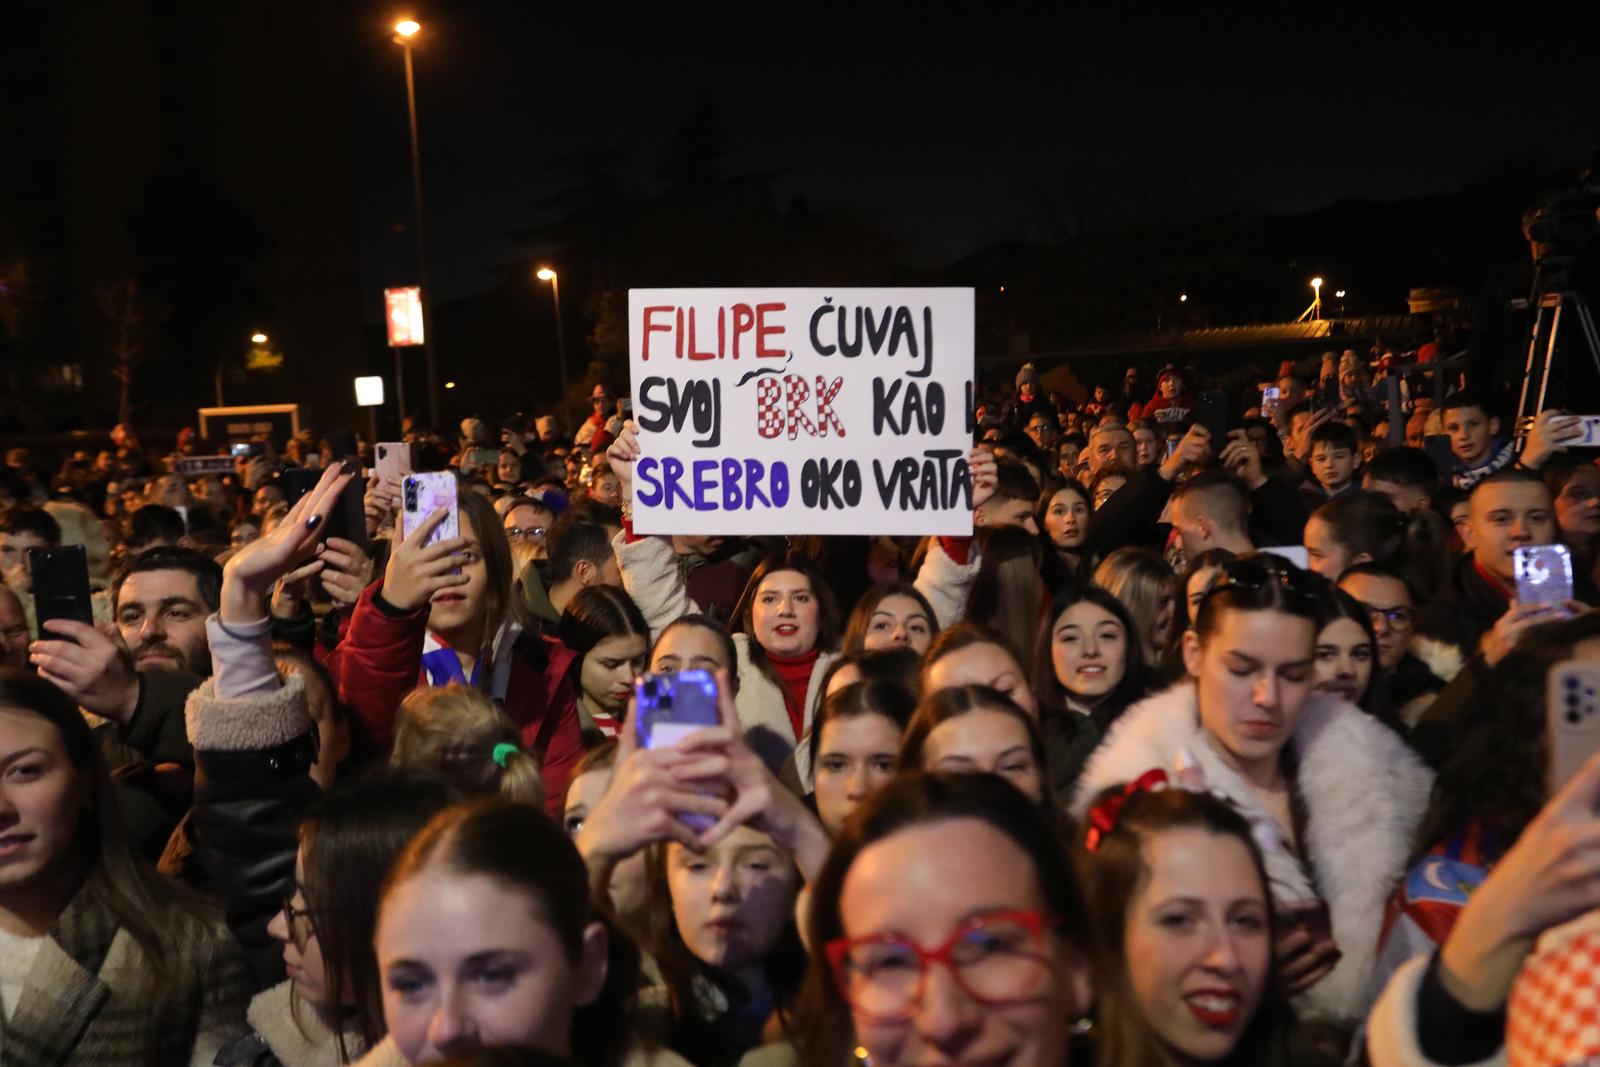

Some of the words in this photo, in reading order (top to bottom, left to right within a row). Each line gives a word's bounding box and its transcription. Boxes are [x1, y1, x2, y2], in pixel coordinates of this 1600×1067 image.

[642, 302, 793, 363] FILIPE,
[809, 296, 932, 378] ČUVAJ
[638, 376, 720, 447] SVOJ
[757, 375, 846, 440] BRK
[872, 376, 945, 436] KAO
[965, 380, 973, 434] I
[636, 457, 789, 510] SREBRO
[800, 457, 862, 510] OKO
[872, 449, 974, 511] VRATA
